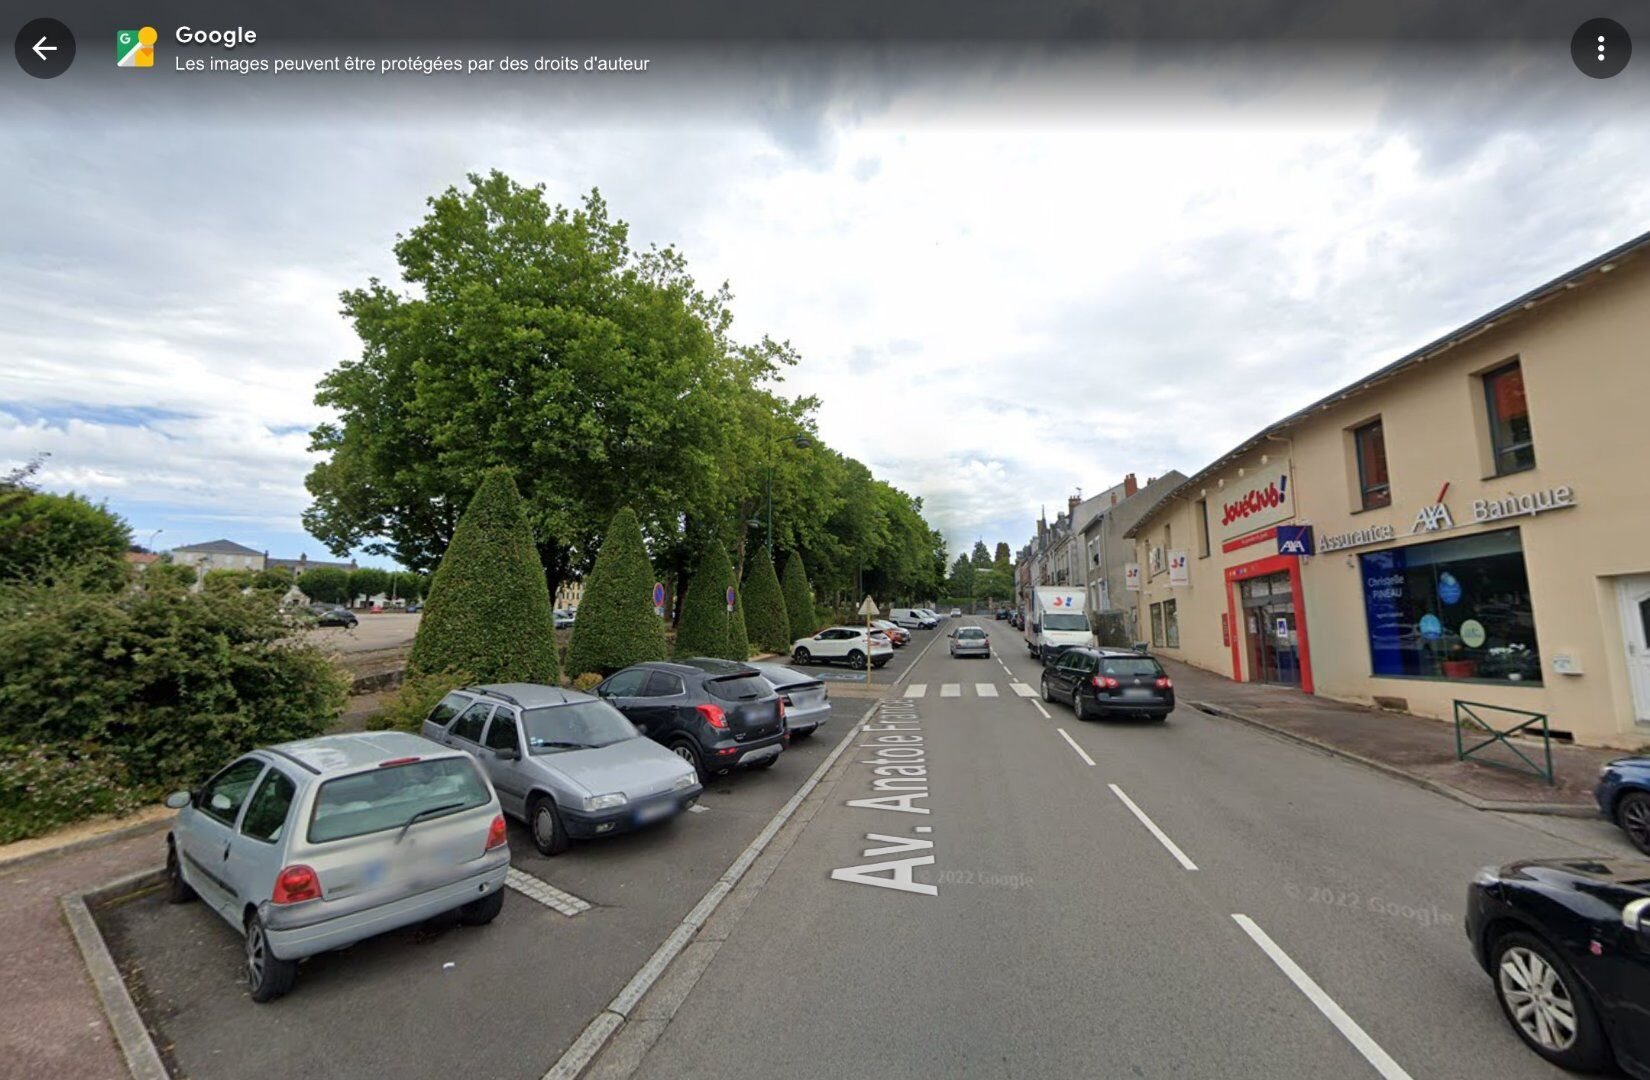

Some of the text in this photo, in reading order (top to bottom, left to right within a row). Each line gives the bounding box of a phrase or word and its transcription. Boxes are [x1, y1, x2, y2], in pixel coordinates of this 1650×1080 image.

[1319, 486, 1573, 550] Assurance AXA Banque
[1280, 540, 1305, 552] AXA
